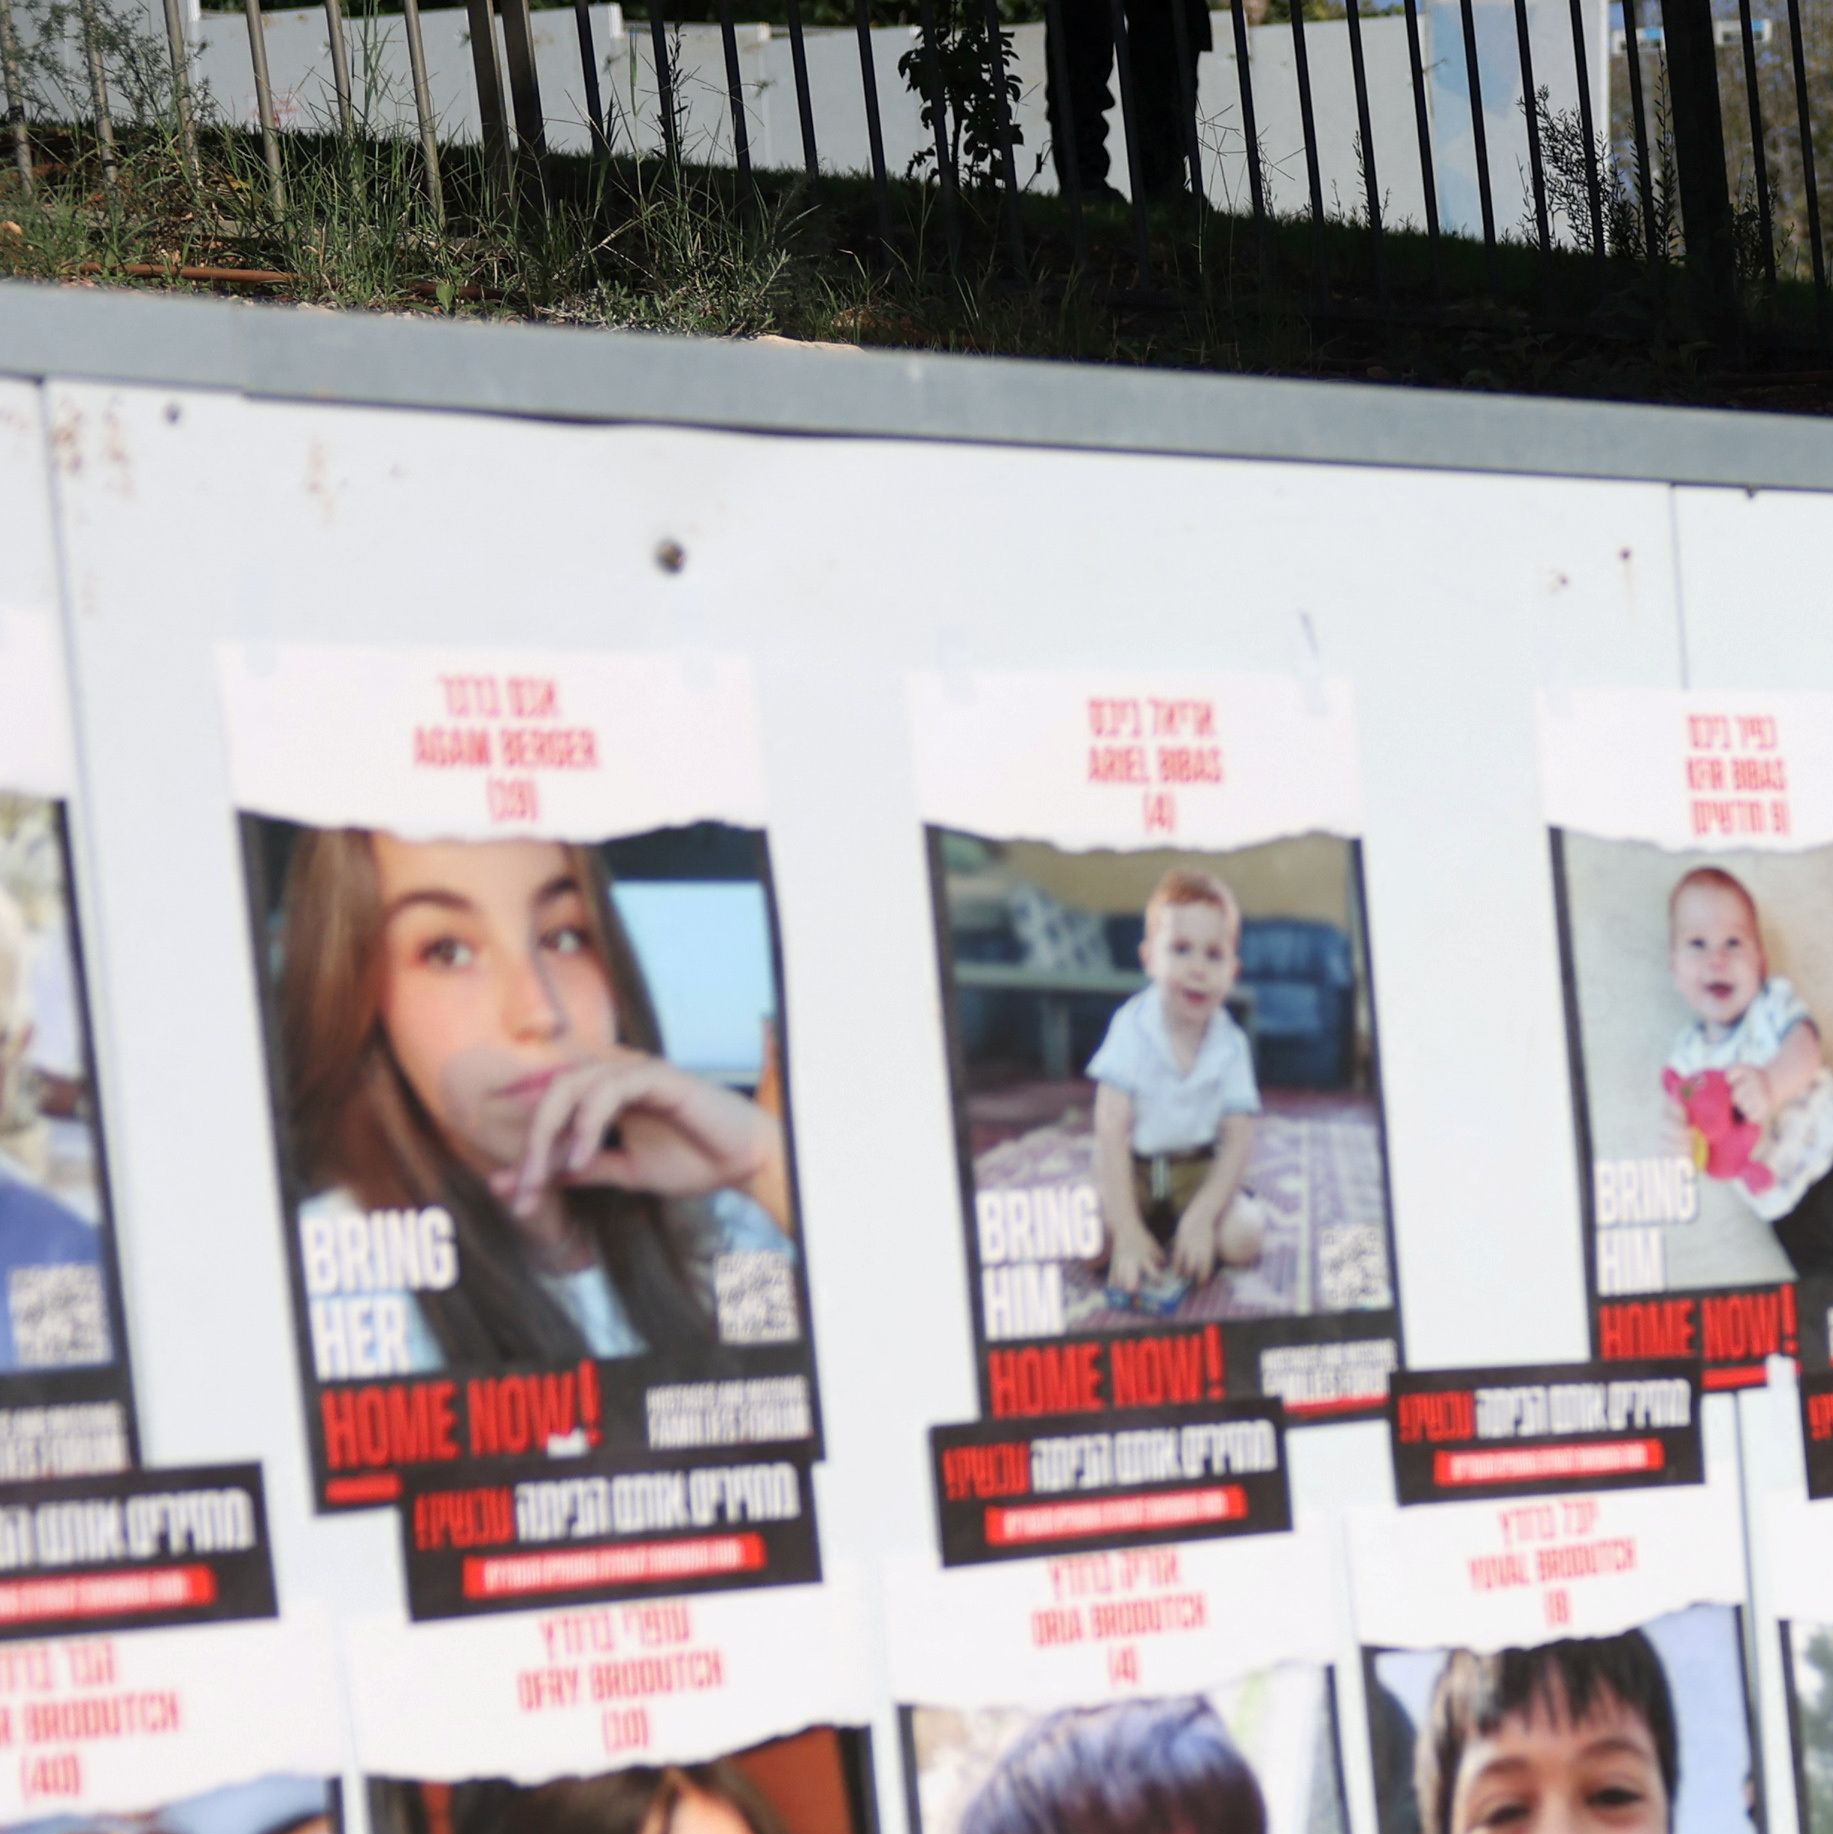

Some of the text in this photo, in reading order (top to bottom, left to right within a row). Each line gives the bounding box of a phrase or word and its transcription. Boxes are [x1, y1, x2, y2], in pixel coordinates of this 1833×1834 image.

[414, 728, 598, 769] AGAM BERGER
[1088, 747, 1223, 786] ARIEL BIBAS
[299, 1208, 457, 1293] BRING
[977, 1188, 1102, 1262] BRING
[309, 1293, 409, 1382] HER
[981, 1265, 1063, 1339] HIM
[989, 1345, 1102, 1417] HOME
[1112, 1327, 1227, 1405] NOW!
[322, 1362, 601, 1466] HOME NOW!
[1033, 1593, 1208, 1646] ORIA BRODUTCH
[24, 1691, 181, 1743] BRODUTCH
[518, 1650, 724, 1712] OFRY BRODUTCH
